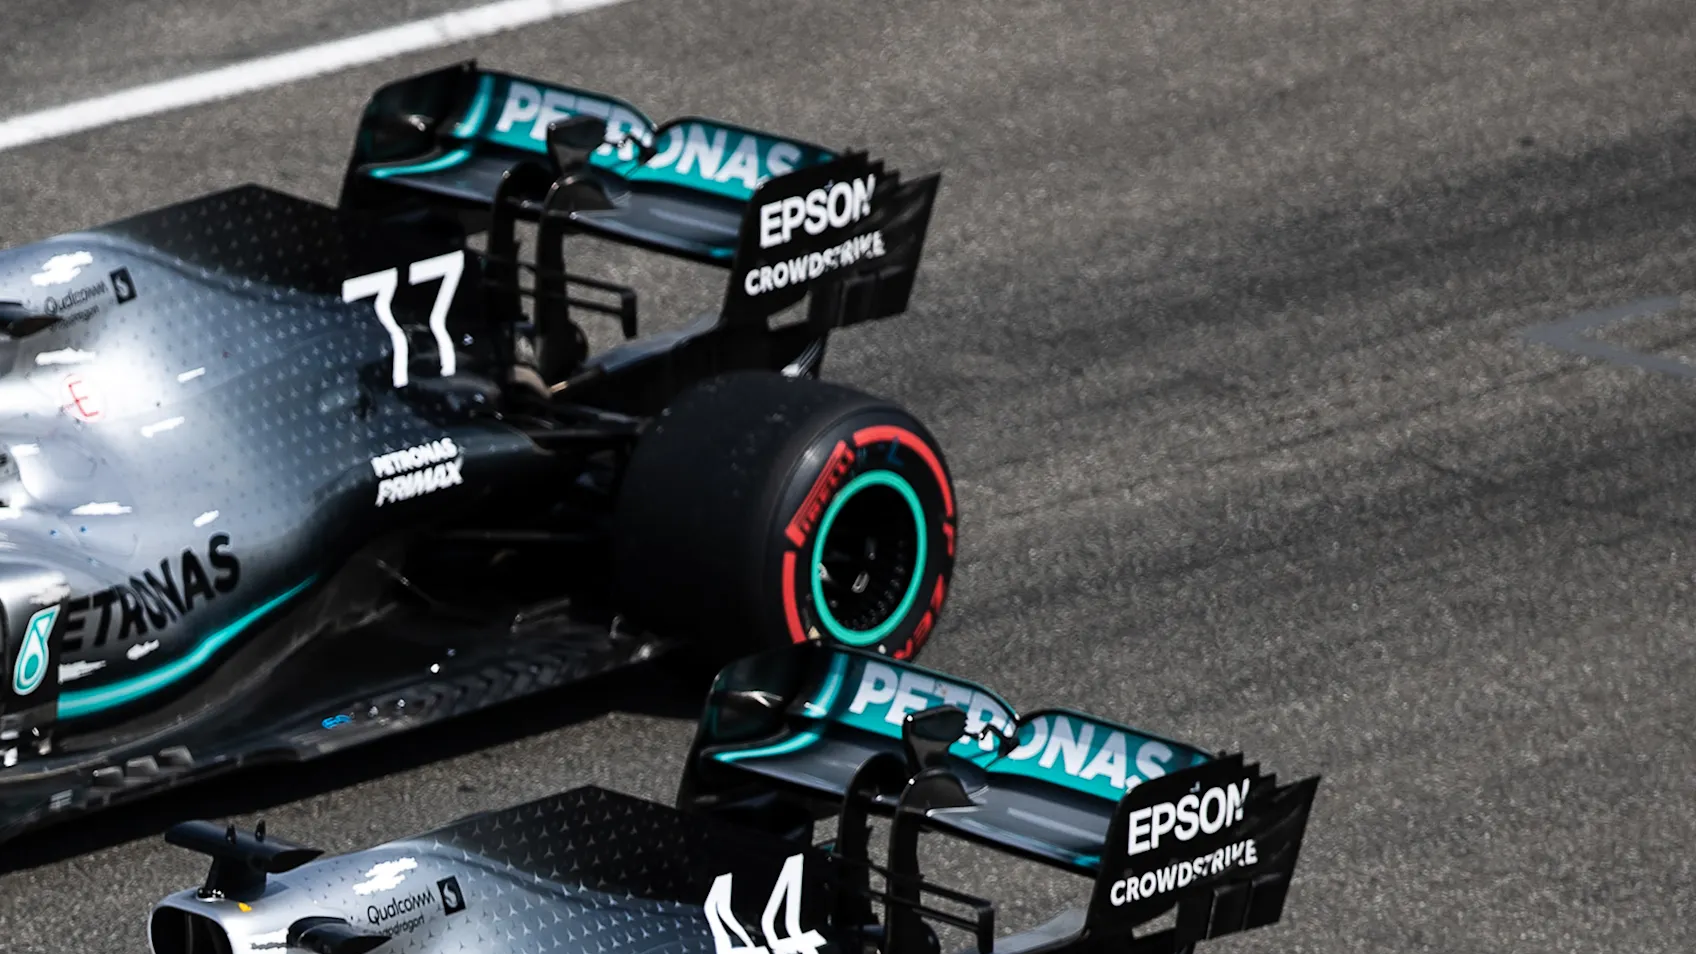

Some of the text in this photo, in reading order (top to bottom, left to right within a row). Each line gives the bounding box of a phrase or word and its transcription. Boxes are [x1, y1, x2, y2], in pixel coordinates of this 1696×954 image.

[759, 173, 877, 249] EPSON
[744, 229, 887, 296] CROWDSTRIKE
[341, 250, 466, 388] 77
[68, 380, 100, 420] E
[60, 534, 241, 653] ETRONAS
[1127, 778, 1251, 856] EPSON
[367, 885, 436, 926] Qualcomm
[1110, 839, 1259, 907] CROWDSTRIKE
